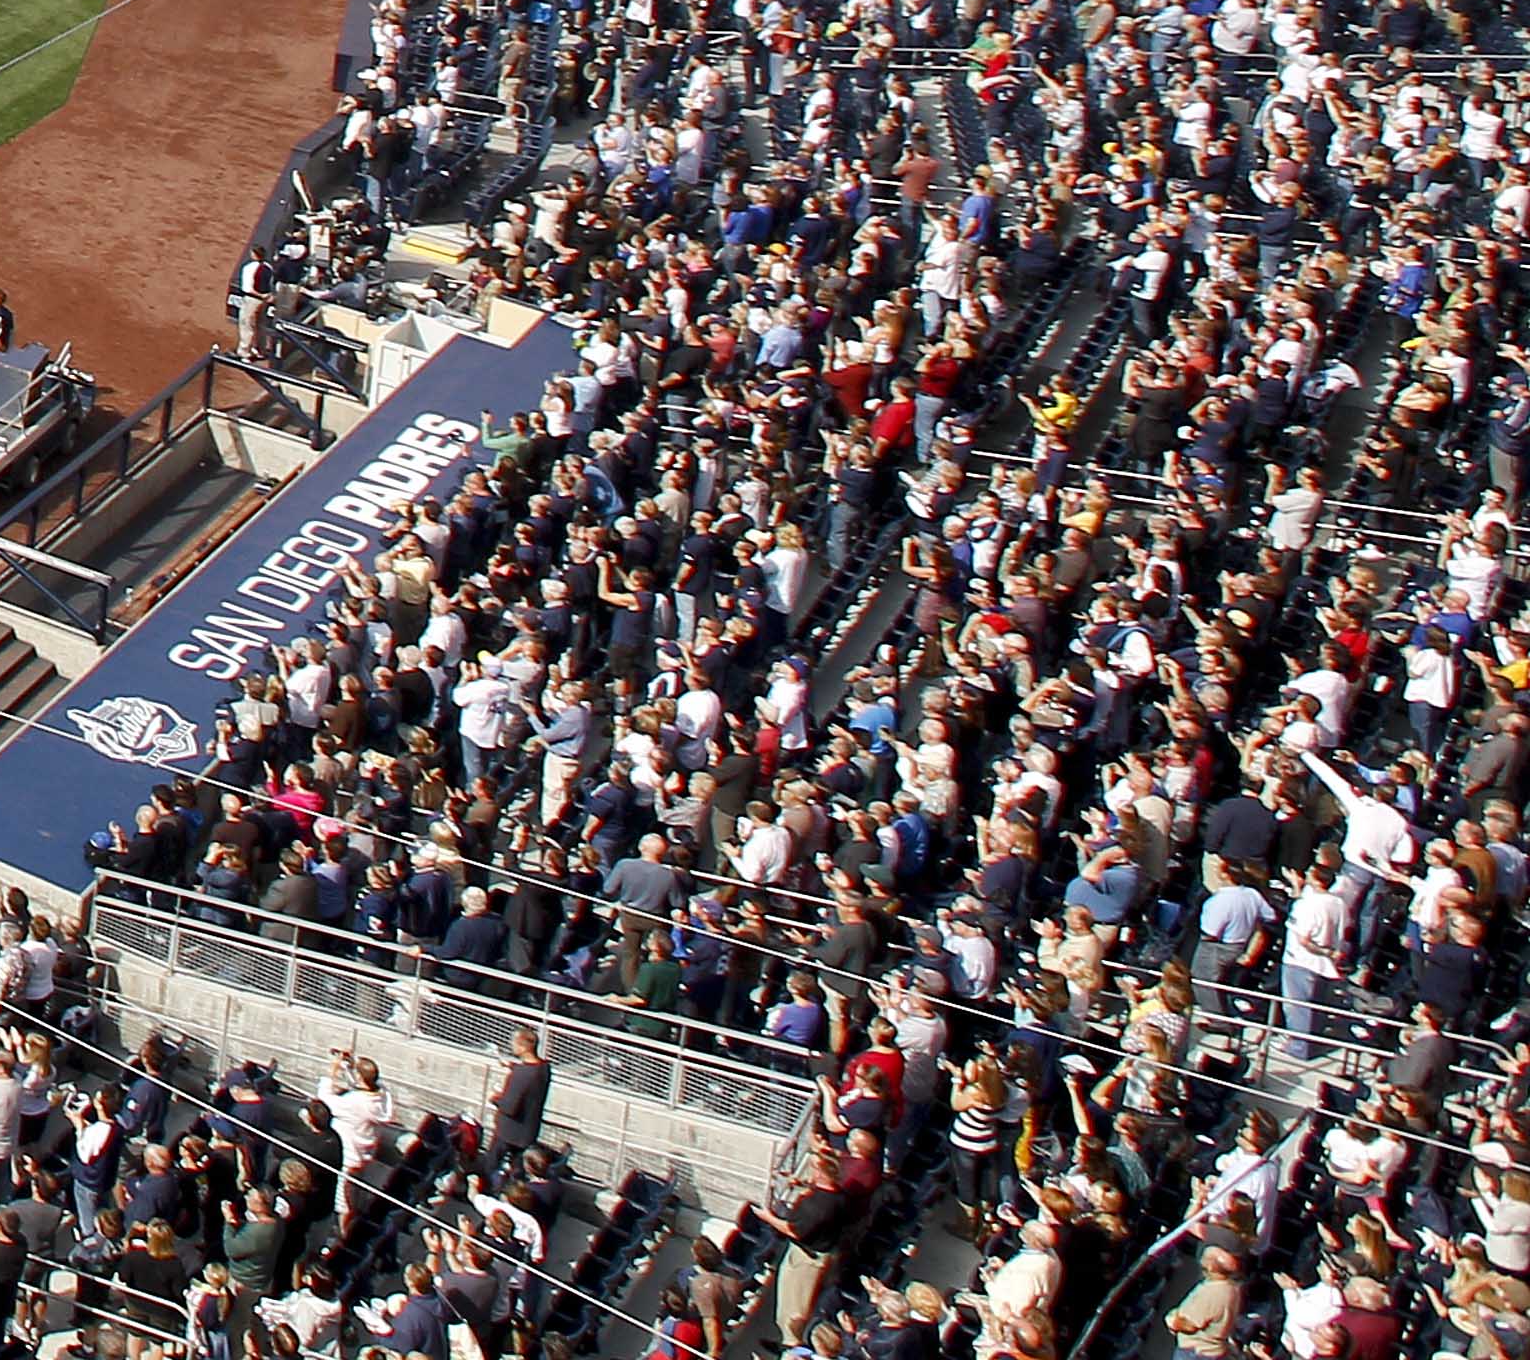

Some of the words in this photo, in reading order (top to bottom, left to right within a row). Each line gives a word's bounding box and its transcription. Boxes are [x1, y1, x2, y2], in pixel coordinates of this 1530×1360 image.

[168, 606, 286, 681] SAN
[239, 518, 370, 613] DIEGO
[324, 411, 481, 530] PADRES
